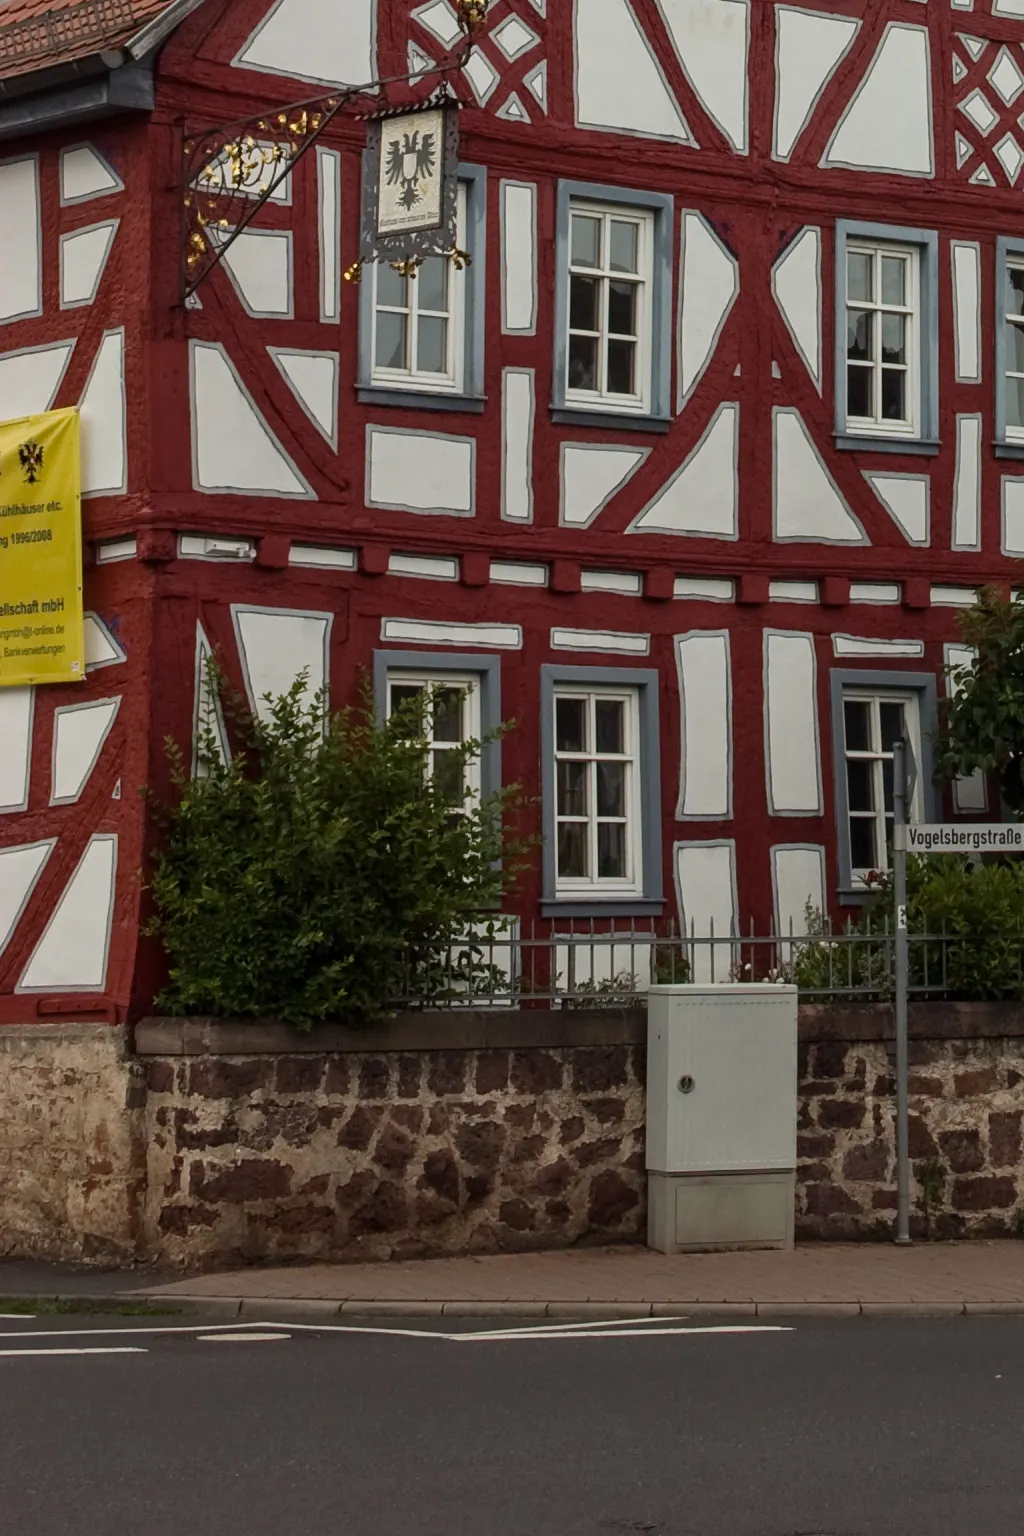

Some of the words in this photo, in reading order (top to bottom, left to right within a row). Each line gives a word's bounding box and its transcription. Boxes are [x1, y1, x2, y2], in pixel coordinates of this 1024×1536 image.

[0, 502, 45, 517] ühlhäuser
[41, 597, 65, 612] mbH
[909, 827, 1022, 849] Vogelsbergstraße
